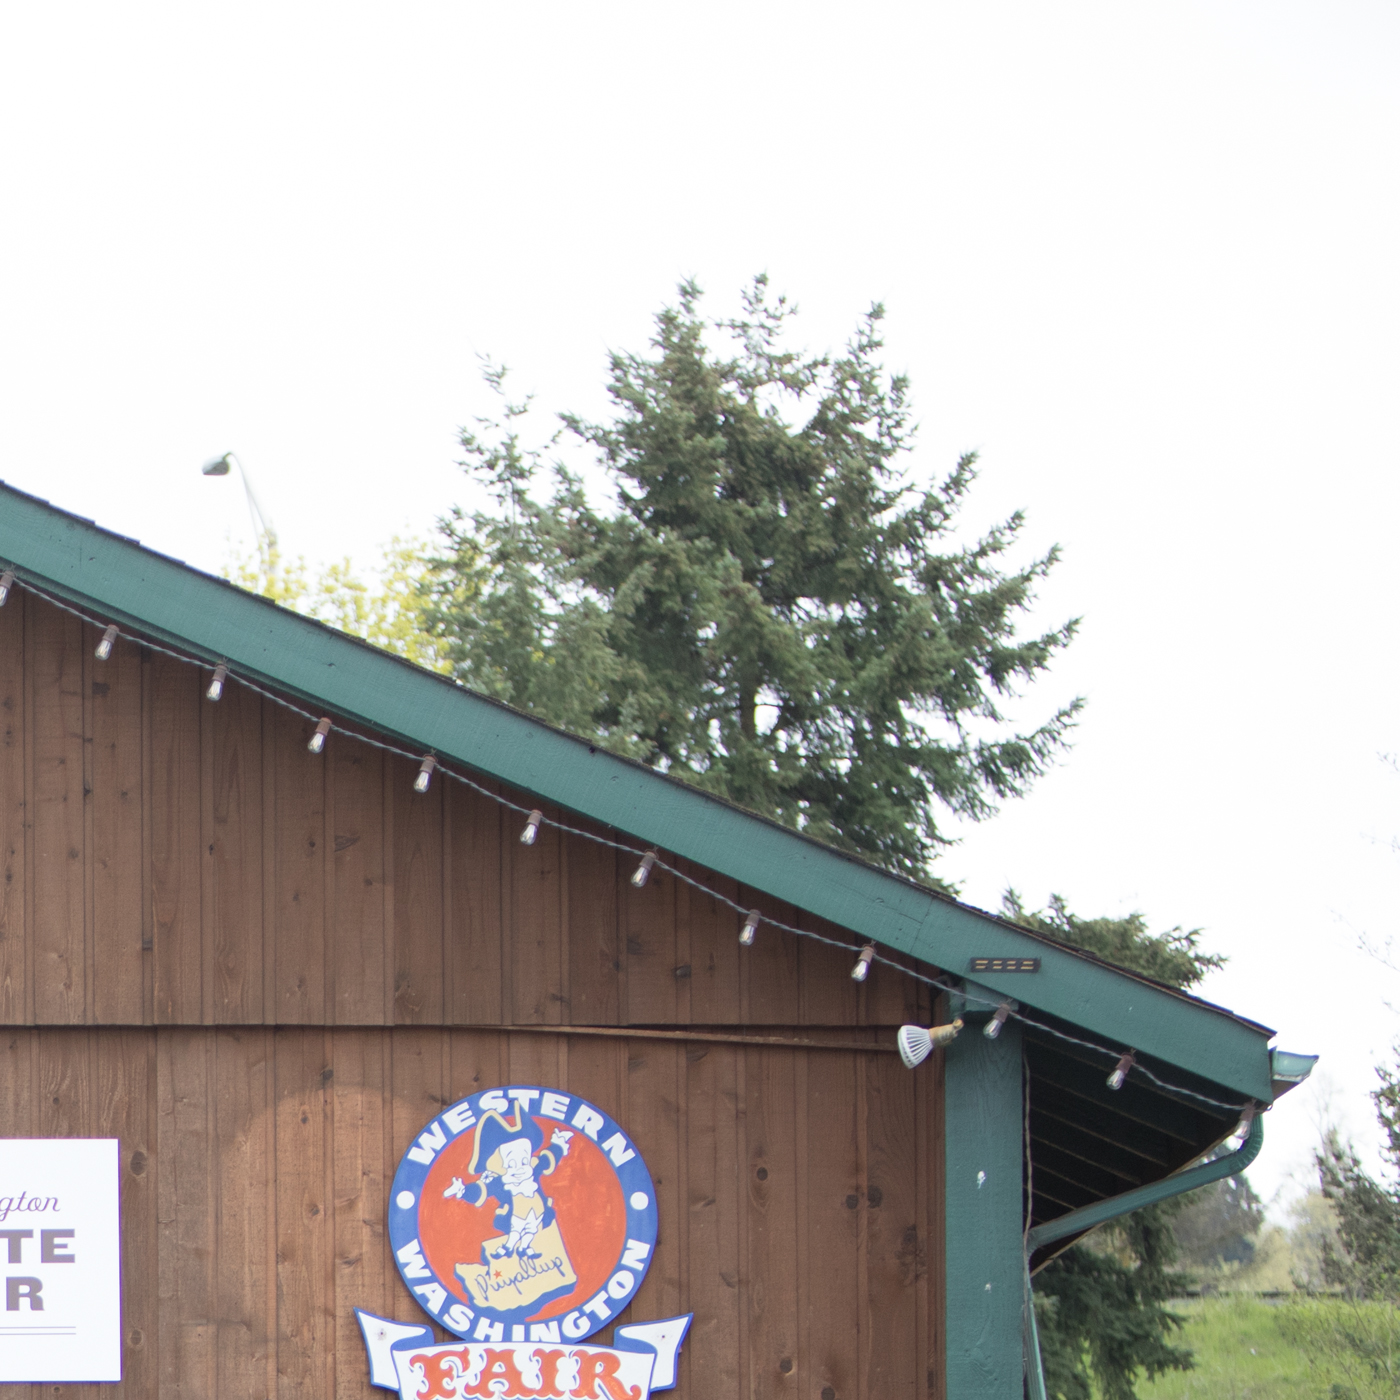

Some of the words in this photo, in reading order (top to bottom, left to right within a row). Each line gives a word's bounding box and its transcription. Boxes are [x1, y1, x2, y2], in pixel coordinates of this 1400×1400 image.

[407, 1089, 636, 1168] WESTERN
[396, 1238, 651, 1344] WASHINGTON
[475, 1257, 565, 1302] Puyallup
